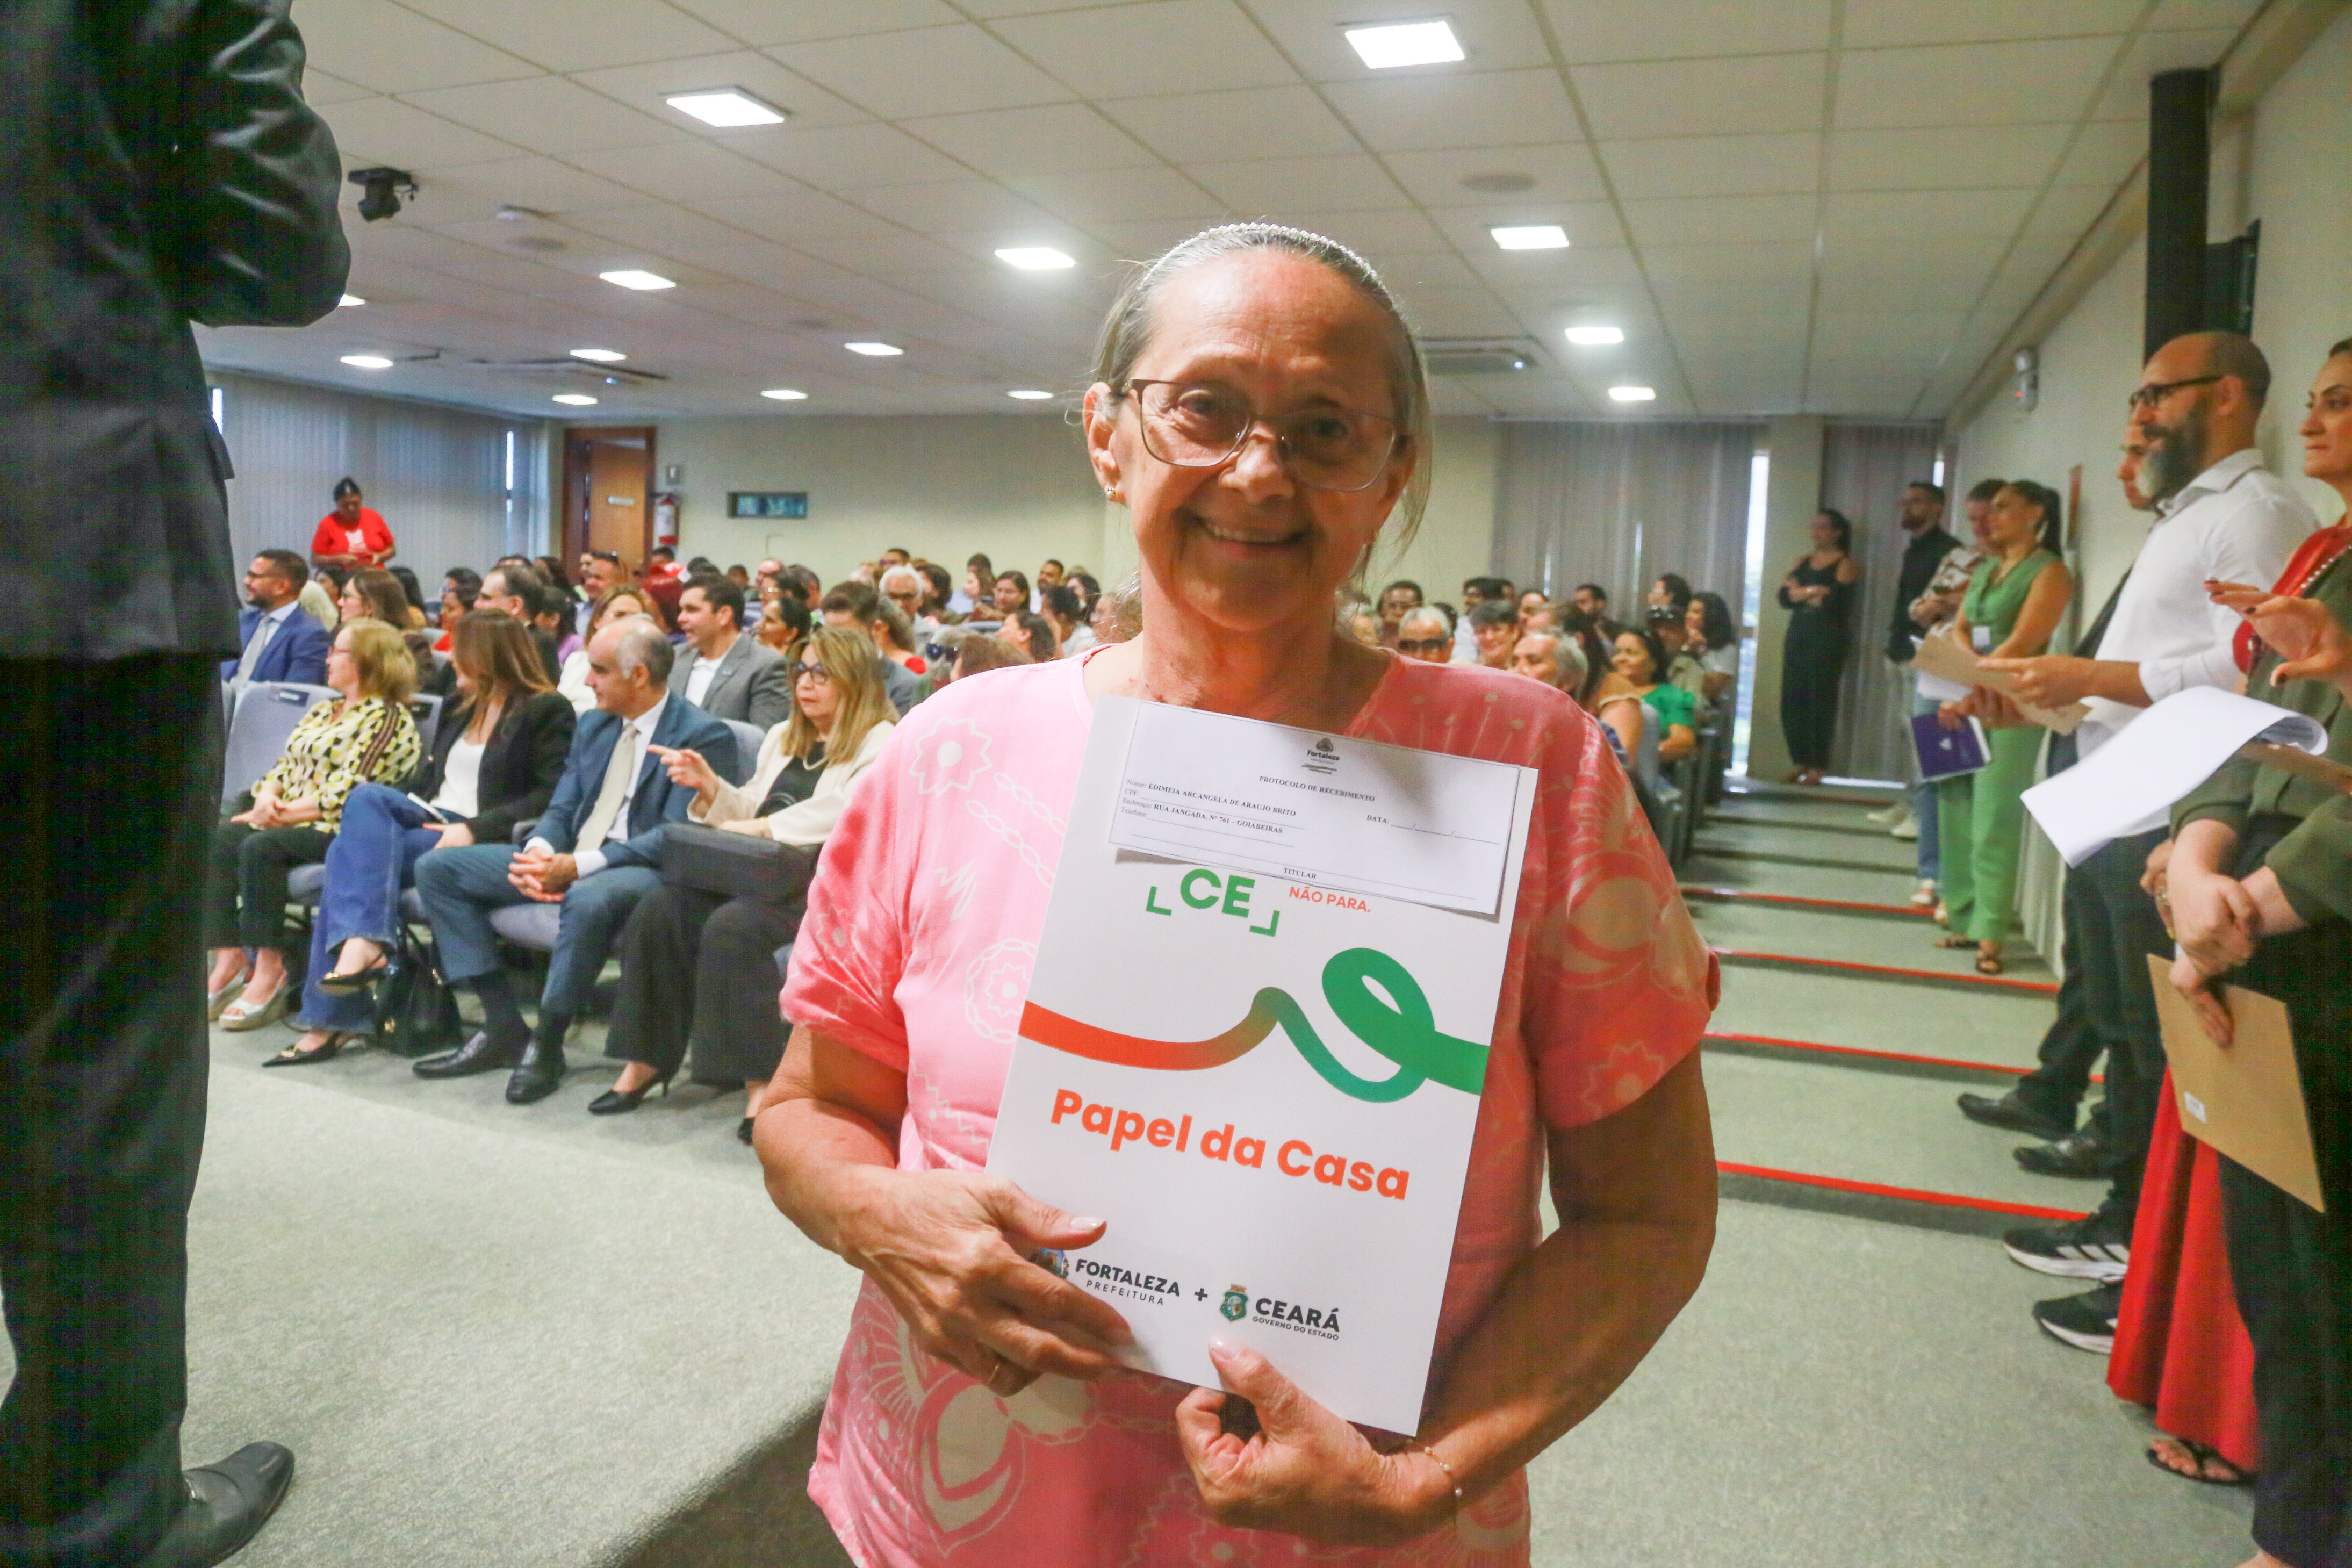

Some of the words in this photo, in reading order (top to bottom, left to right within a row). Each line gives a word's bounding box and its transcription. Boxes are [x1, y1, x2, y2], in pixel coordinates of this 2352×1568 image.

[1307, 750, 1340, 761] Fortaleza
[1126, 779, 1147, 788] Nome:
[1148, 783, 1180, 795] EDIMEIA
[1182, 790, 1227, 804] ARCANGELA
[1241, 802, 1271, 812] ARAUJO
[1272, 807, 1296, 817] BRITO
[1259, 775, 1306, 789] PROTOCOLO
[1319, 787, 1375, 802] RECEBIMENTO
[1123, 797, 1152, 809] Endereço:
[1154, 803, 1169, 812] RUA
[1171, 807, 1207, 821] JANGADA,
[1236, 819, 1283, 833] GOIABEIRAS
[1366, 815, 1389, 824] DATA:
[1283, 868, 1317, 879] TITULAR
[1180, 868, 1255, 918] CE
[1289, 886, 1323, 903] NÃO
[1326, 894, 1371, 913] PARA.
[1051, 1088, 1192, 1153] Papel
[1200, 1123, 1266, 1169] da
[1277, 1140, 1410, 1201] Casa
[1075, 1258, 1180, 1297] FORTALEZA
[1086, 1279, 1164, 1306] PREFEITURA
[1253, 1316, 1292, 1330] GOVERNO
[1293, 1325, 1306, 1333] DO
[1307, 1329, 1339, 1341] ESTADO
[1255, 1298, 1340, 1333] CEARÁ
